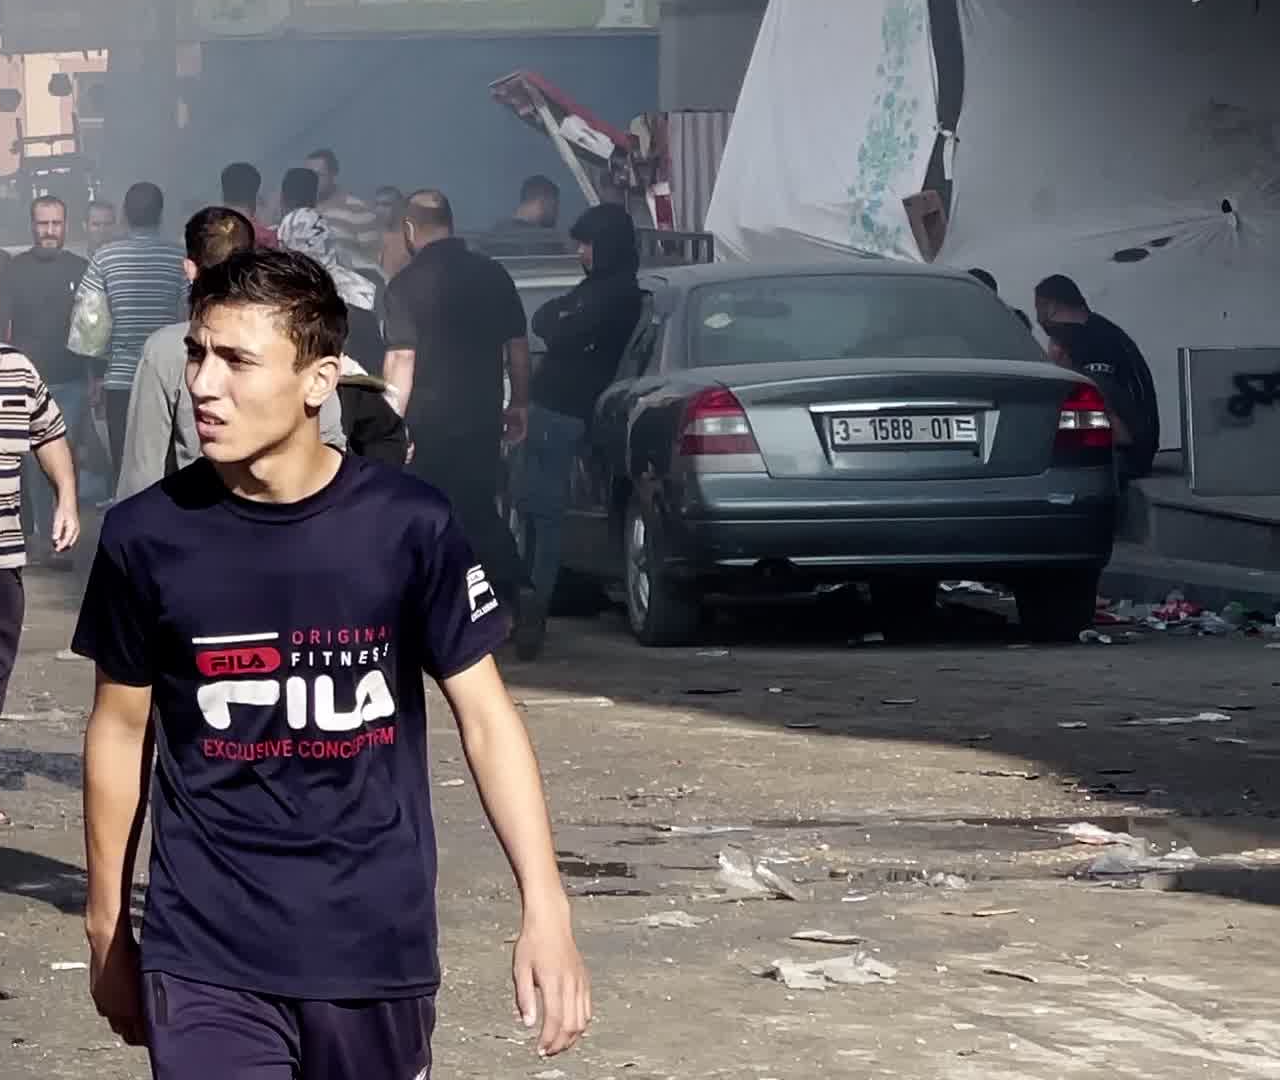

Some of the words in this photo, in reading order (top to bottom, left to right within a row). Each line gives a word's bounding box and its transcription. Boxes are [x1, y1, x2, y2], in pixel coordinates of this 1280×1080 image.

[292, 626, 387, 645] ORIGINA
[210, 654, 266, 672] FILA
[197, 670, 395, 731] FILA
[203, 738, 293, 761] EXCLUSIVE
